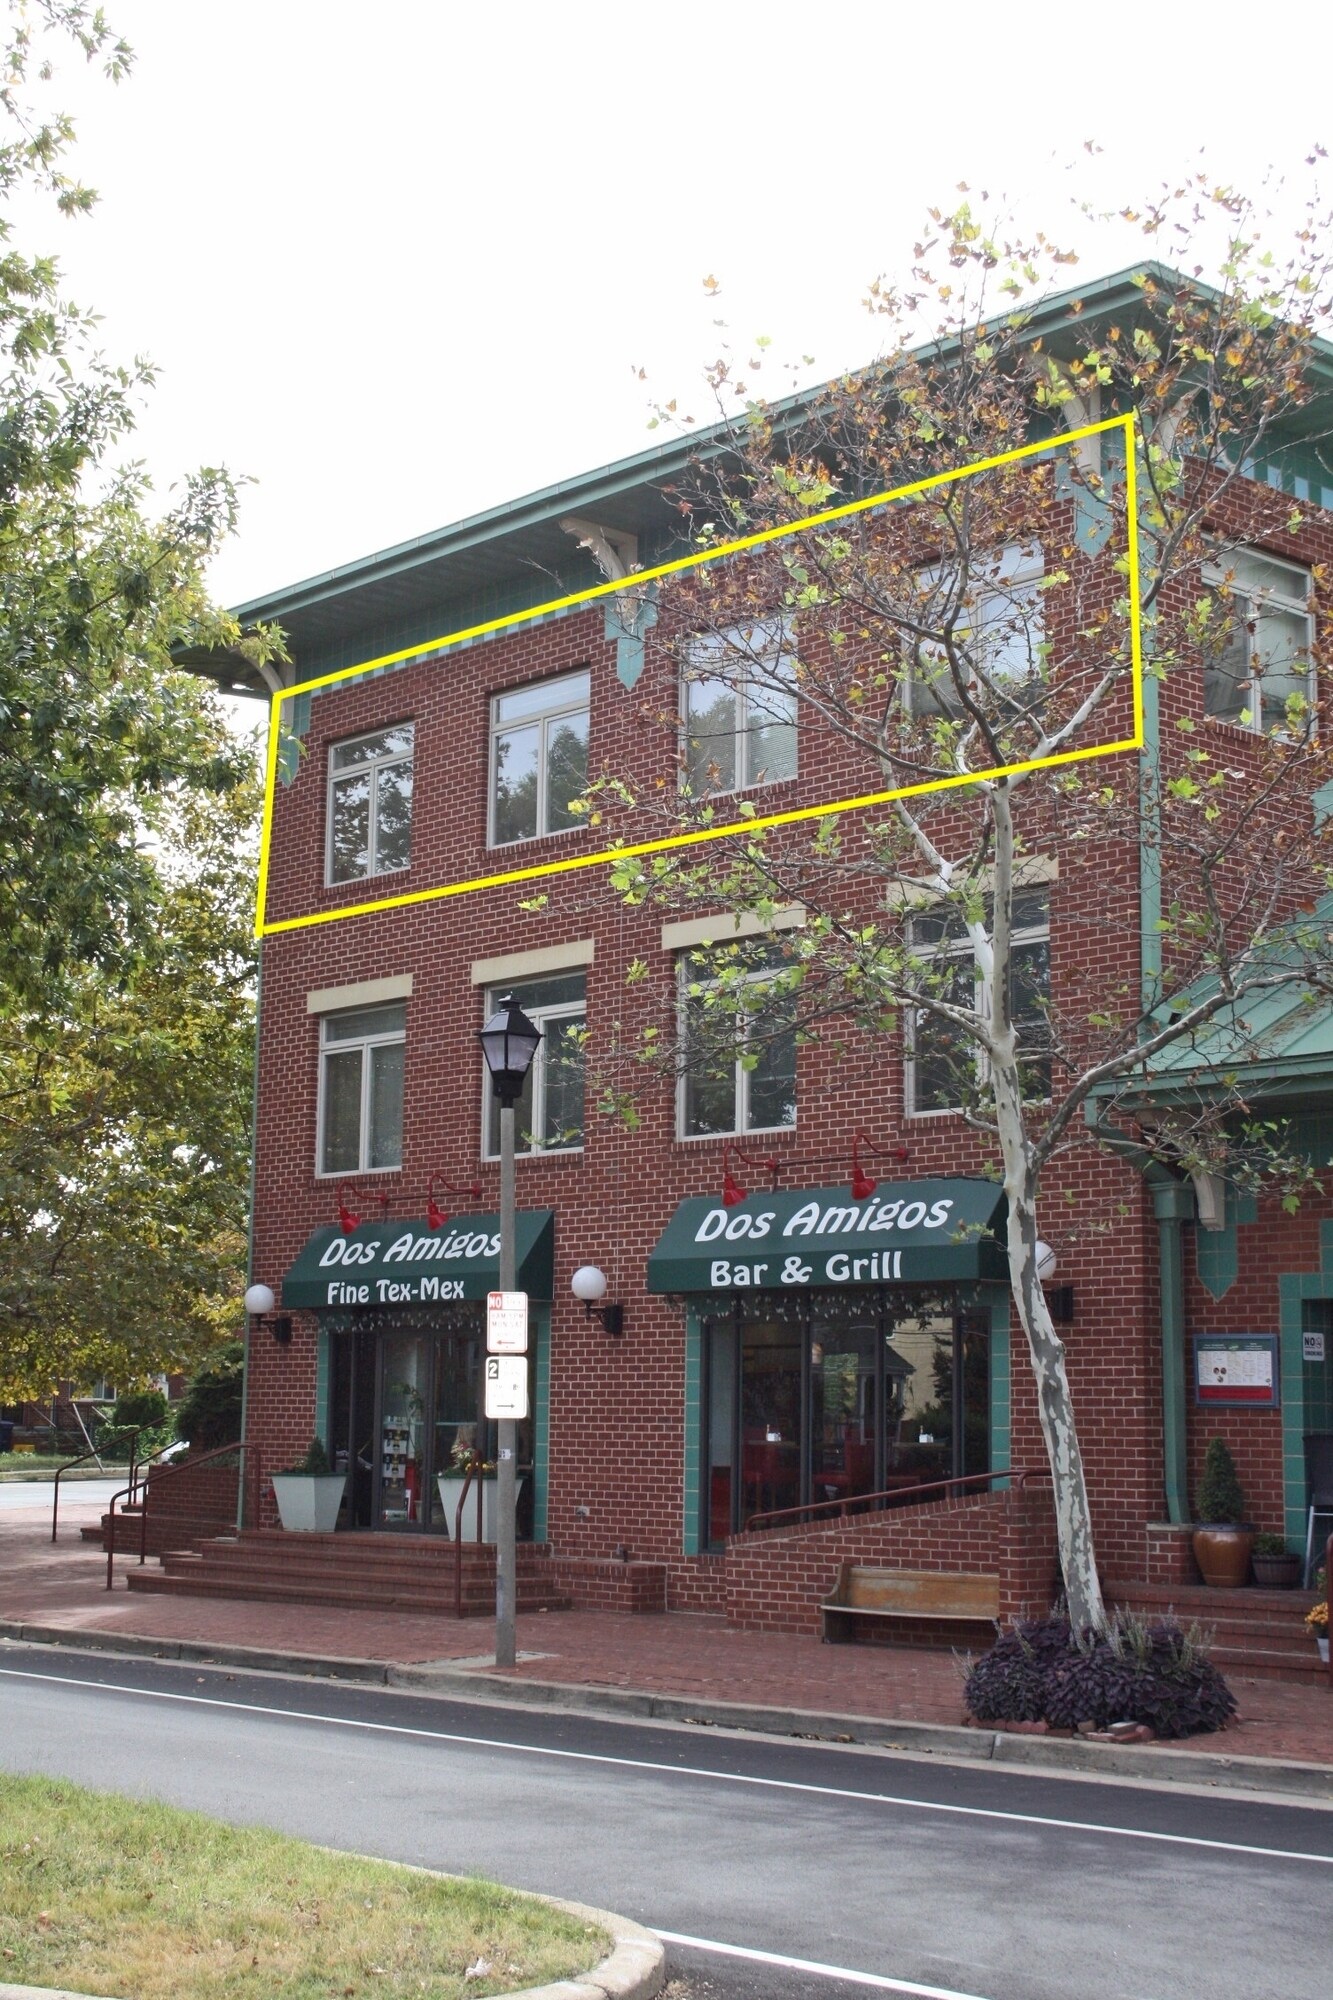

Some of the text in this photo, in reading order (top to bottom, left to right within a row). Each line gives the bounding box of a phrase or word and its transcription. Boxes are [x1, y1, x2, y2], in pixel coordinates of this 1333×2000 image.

[695, 1197, 953, 1242] Dos Amigos
[319, 1229, 501, 1267] Dos Amigos
[710, 1251, 902, 1287] Bar & Grill
[327, 1276, 465, 1305] Fine Tex-Mex
[489, 1296, 502, 1309] NO
[1304, 1336, 1315, 1346] NO
[488, 1362, 498, 1378] 2
